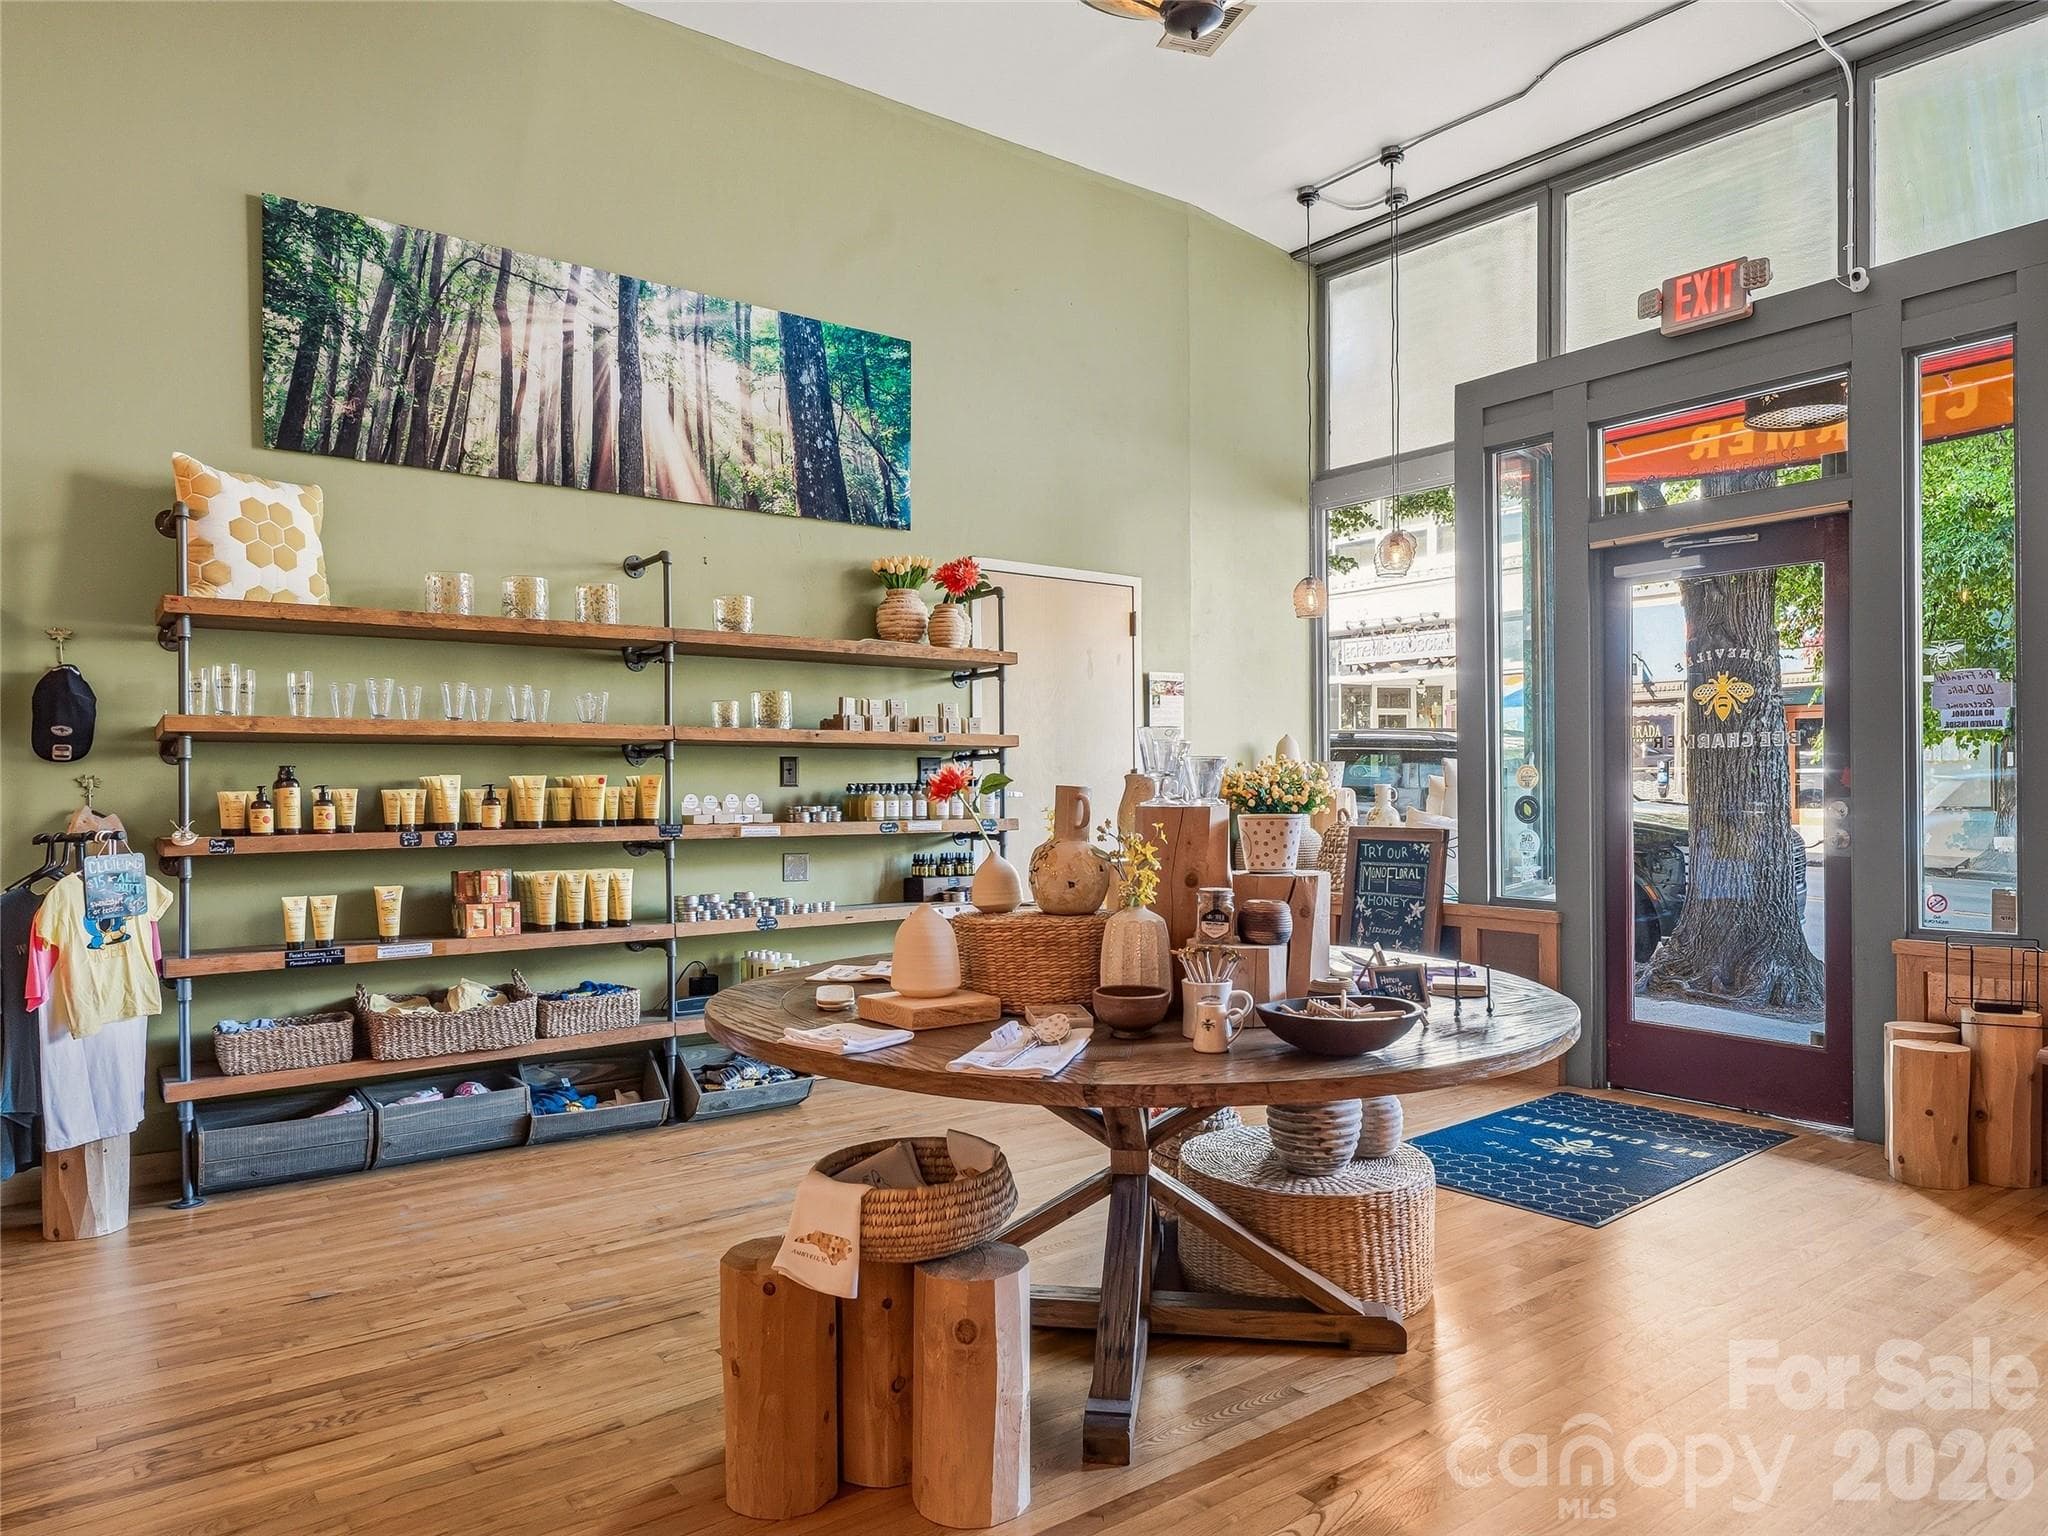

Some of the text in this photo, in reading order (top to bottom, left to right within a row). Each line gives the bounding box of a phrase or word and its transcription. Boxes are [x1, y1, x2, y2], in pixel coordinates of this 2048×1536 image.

[1674, 262, 1738, 322] EXIT
[1361, 843, 1409, 859] TRY OUR
[1367, 894, 1409, 907] HONEY
